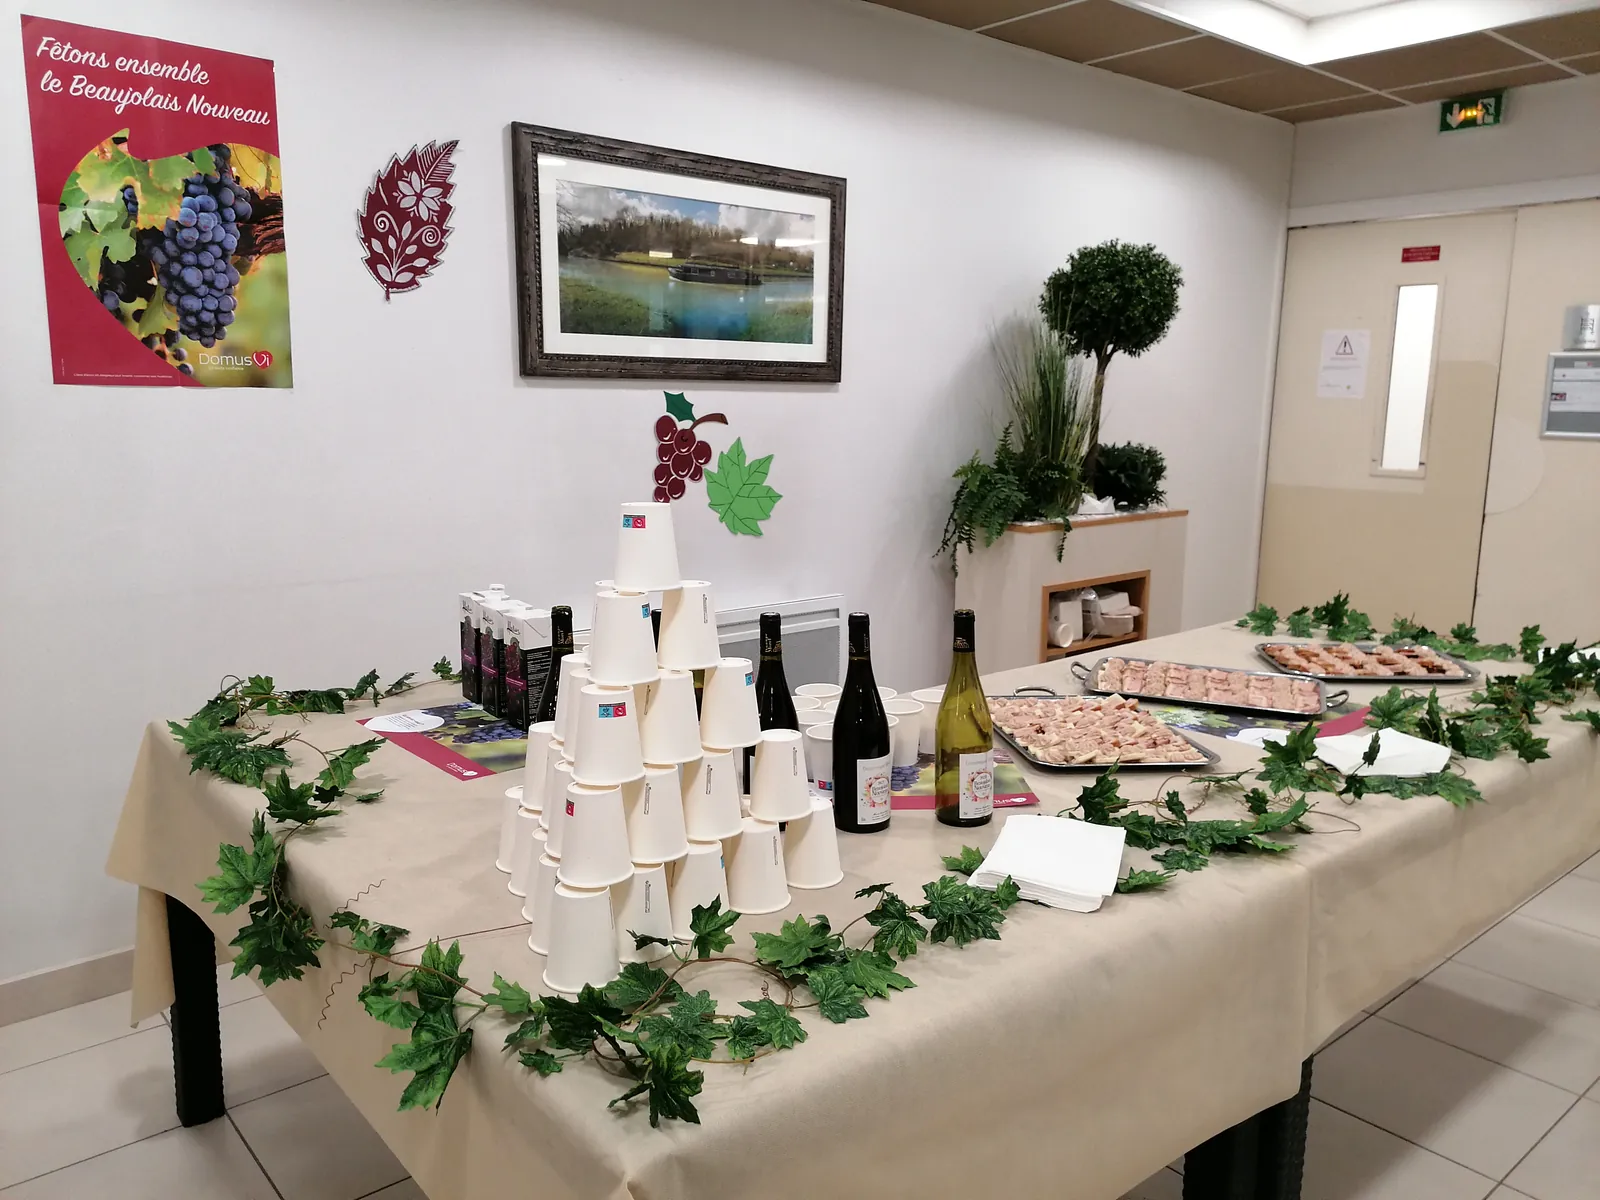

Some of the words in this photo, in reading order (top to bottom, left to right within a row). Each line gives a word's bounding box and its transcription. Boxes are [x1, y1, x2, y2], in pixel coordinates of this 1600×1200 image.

[36, 36, 110, 69] Fêtons
[115, 56, 210, 85] ensemble
[40, 70, 64, 94] le
[69, 74, 182, 115] Beaujolais
[185, 93, 271, 126] Nouveau
[198, 352, 271, 367] DomusVi
